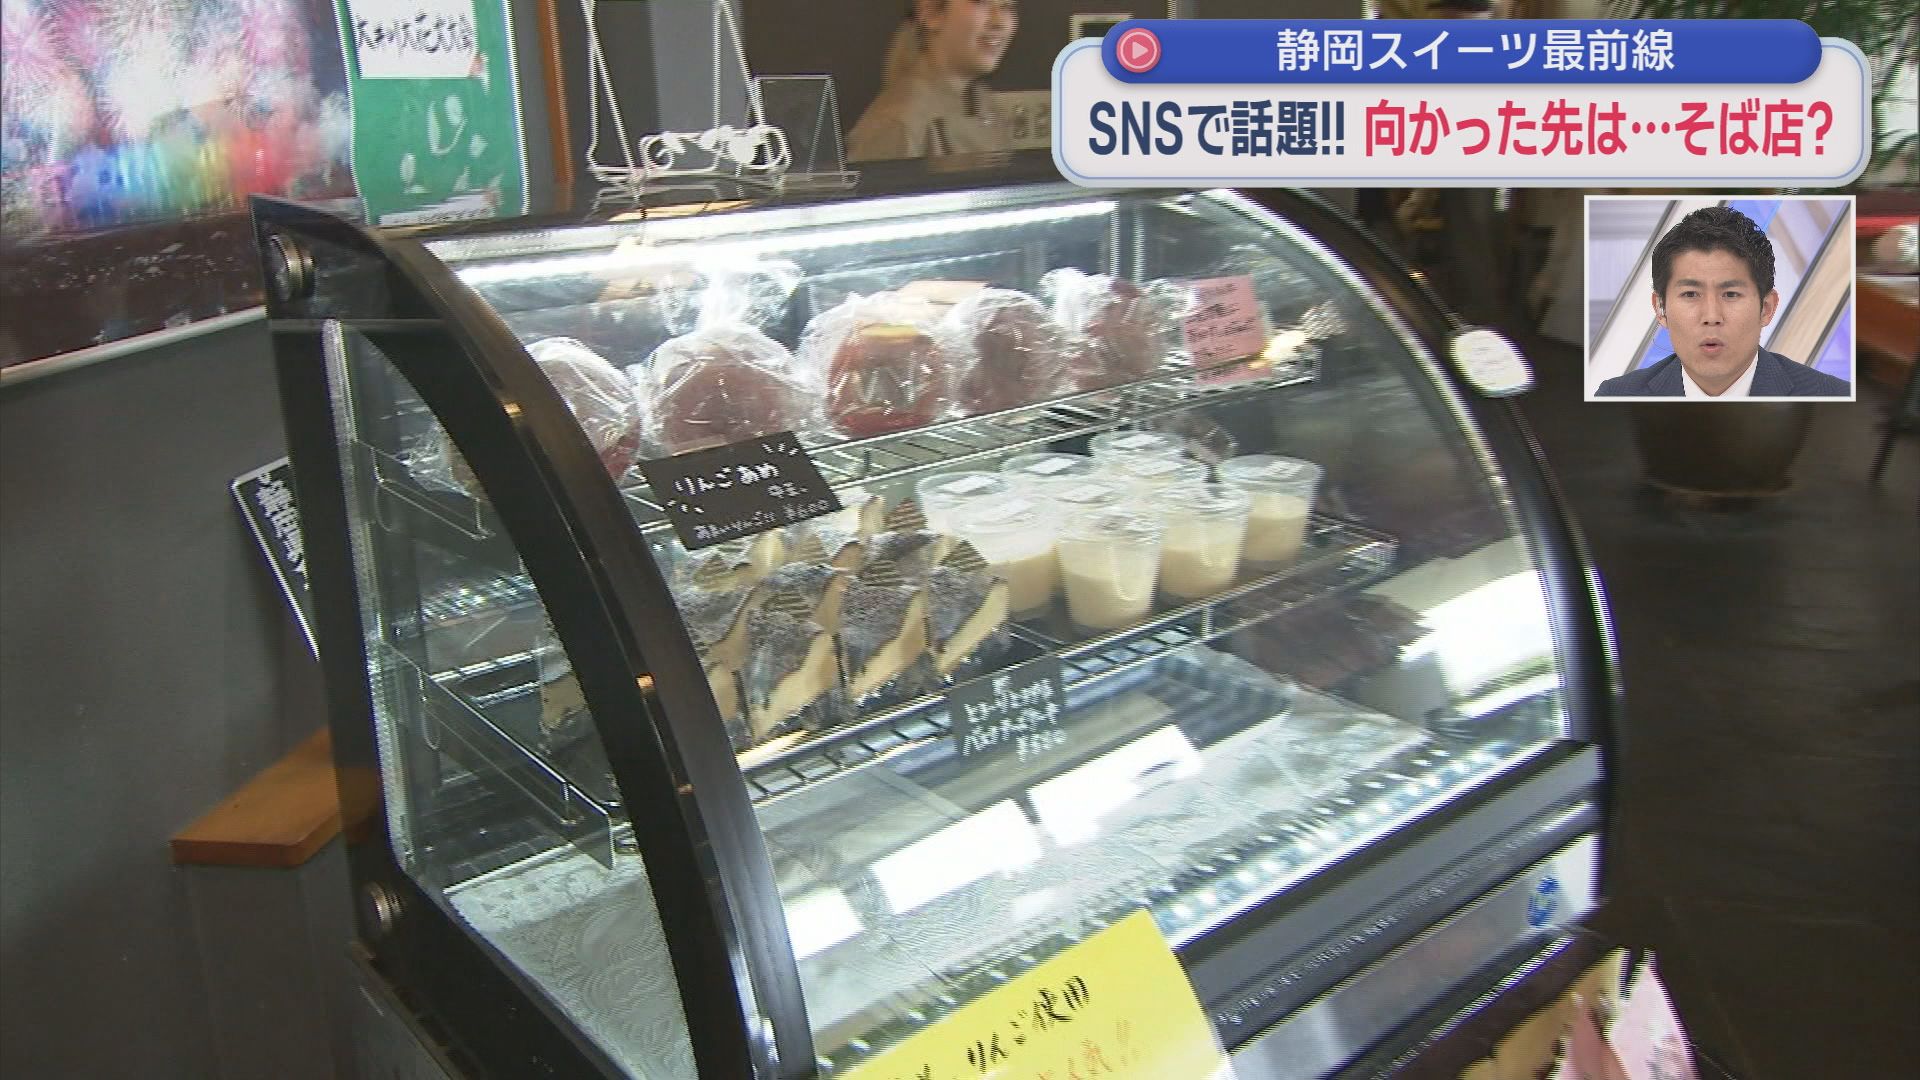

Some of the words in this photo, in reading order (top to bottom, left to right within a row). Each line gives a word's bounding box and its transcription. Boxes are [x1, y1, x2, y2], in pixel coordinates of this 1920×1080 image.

[671, 462, 779, 496] りんごあめ
[966, 975, 1090, 1073] りんご使用
